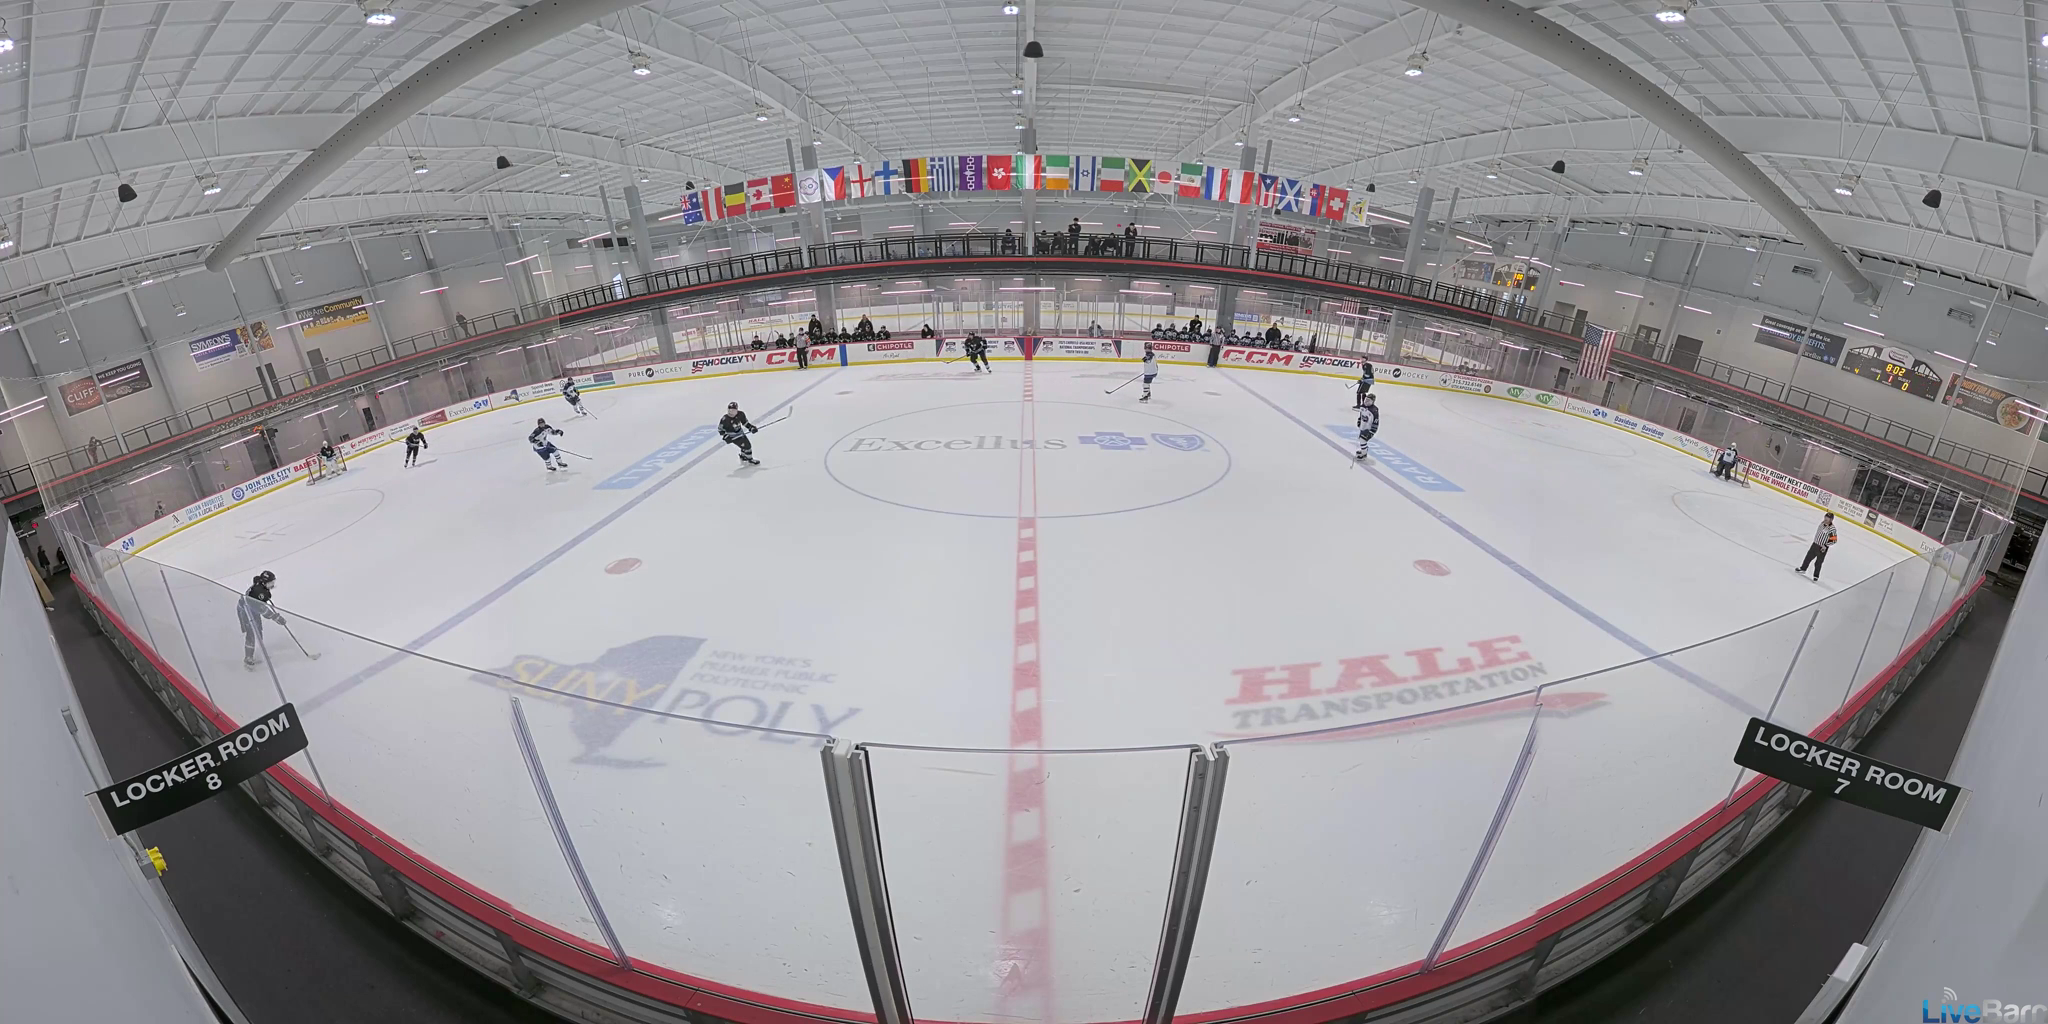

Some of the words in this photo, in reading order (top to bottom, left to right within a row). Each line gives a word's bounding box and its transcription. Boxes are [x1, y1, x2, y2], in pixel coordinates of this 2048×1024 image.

[1764, 318, 1776, 326] Great
[1776, 322, 1796, 332] coverage
[876, 342, 913, 350] CHIPOTLE
[1154, 342, 1190, 352] CHIPOTLE
[1797, 334, 1826, 350] BEEFITS.
[126, 362, 142, 370] GOING
[1222, 350, 1294, 366] CCM
[1886, 364, 1906, 376] 8:02
[1902, 382, 1908, 390] 0
[1954, 378, 1977, 392] HNGRY
[448, 406, 474, 418] Excellus
[1567, 402, 1592, 416] Excellus
[1614, 416, 1638, 428] Davidson
[1642, 424, 1664, 437] Davidson
[847, 436, 1068, 452] Excellus
[244, 480, 261, 492] JOIN
[262, 474, 276, 484] THE
[276, 466, 292, 478] CITY
[1760, 474, 1771, 482] THE
[1771, 479, 1790, 491] WHOLE
[1790, 486, 1809, 498] TEAM!
[1770, 470, 1788, 482] RIGHT
[1788, 476, 1802, 488] NEXT
[1802, 484, 1820, 494] DOOR
[708, 648, 746, 662] NEW
[755, 656, 814, 668] YORK'S
[699, 660, 771, 677] PREMIER
[774, 670, 838, 684] PUBLIC
[1224, 634, 1534, 705] HALE
[498, 657, 668, 716] SUNY
[689, 672, 810, 696] POLYTECHNIC
[1232, 662, 1548, 730] TRANSPORTATION
[652, 687, 862, 748] POLY
[110, 752, 216, 808] LOCKER
[218, 712, 290, 762] ROOM
[1754, 726, 1861, 778] LOCKER
[1864, 765, 1947, 804] ROOM
[206, 772, 222, 790] 8
[1834, 778, 1850, 794] 7
